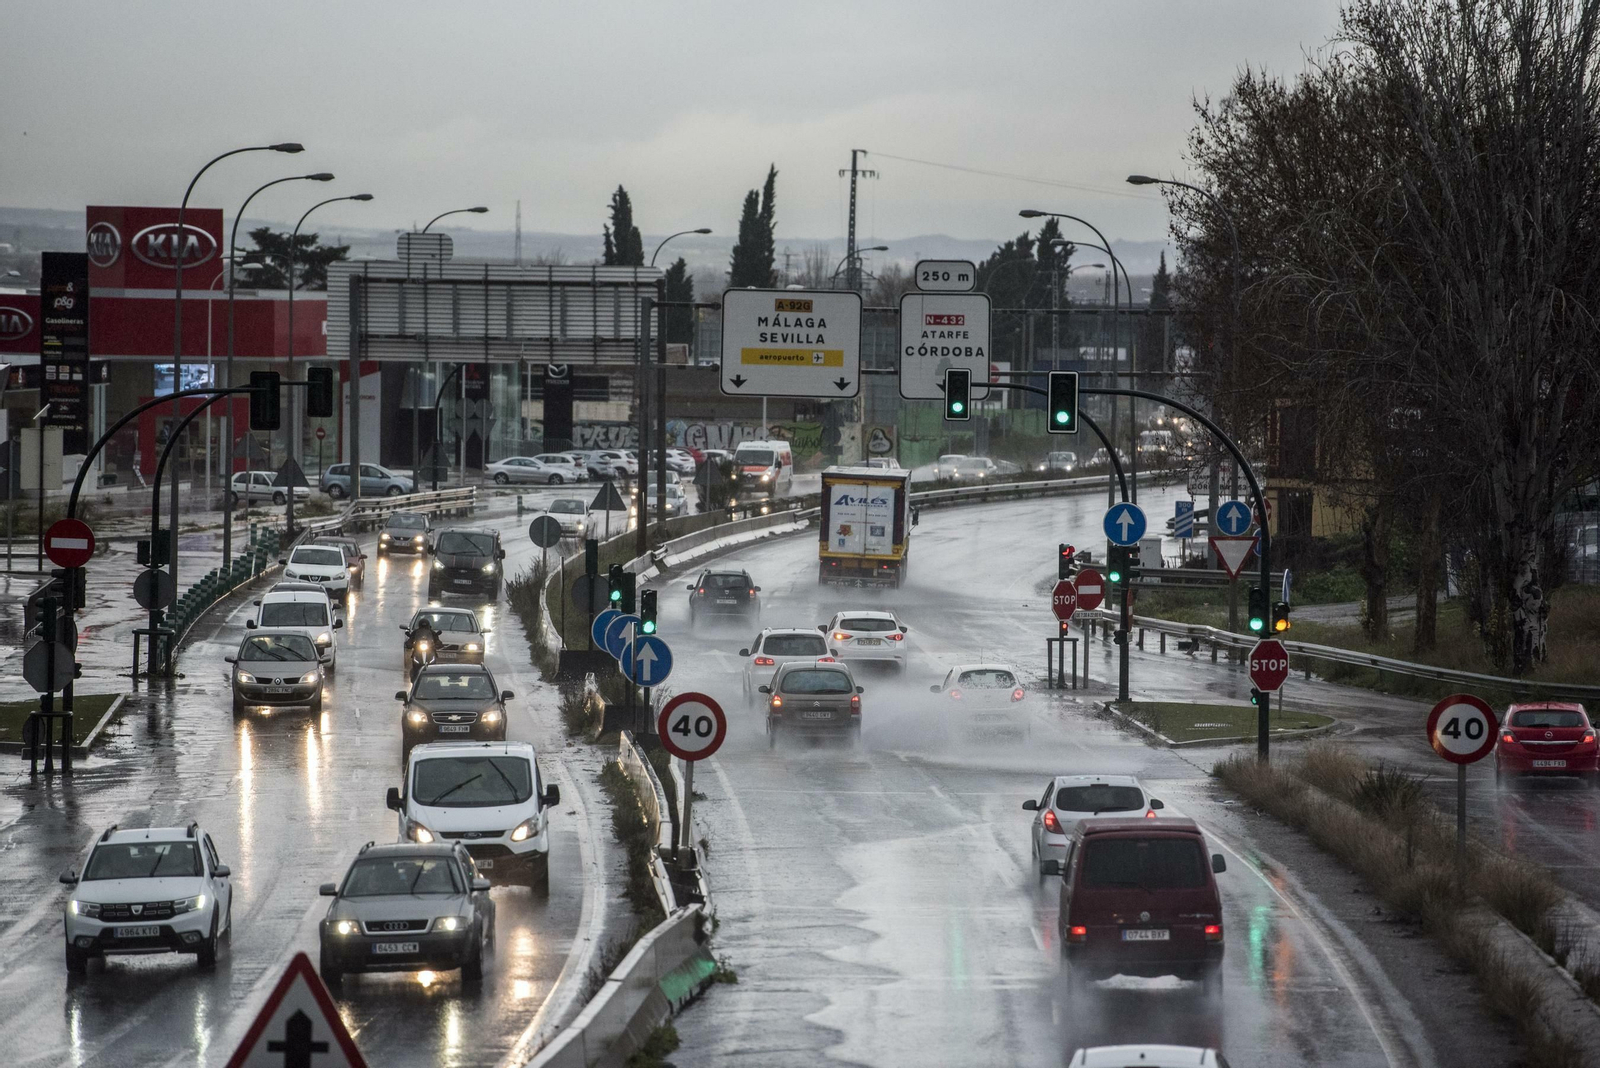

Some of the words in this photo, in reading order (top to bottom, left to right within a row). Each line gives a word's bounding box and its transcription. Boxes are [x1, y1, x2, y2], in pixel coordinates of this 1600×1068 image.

[148, 233, 203, 257] KIA
[922, 271, 950, 282] 250
[958, 273, 969, 282] m
[777, 301, 811, 311] A-92G
[45, 317, 84, 325] Gasolineras
[757, 313, 827, 329] MÁLAGA
[926, 316, 965, 325] N-432
[759, 332, 825, 345] SEVILLA
[921, 330, 969, 340] ATARFE
[905, 342, 985, 358] CÓRDOBA
[1054, 595, 1076, 605] STOP
[1252, 659, 1287, 671] STOP
[672, 714, 713, 738] 40
[1441, 717, 1484, 740] 40
[119, 927, 140, 937] 4964
[1127, 930, 1149, 939] 0744
